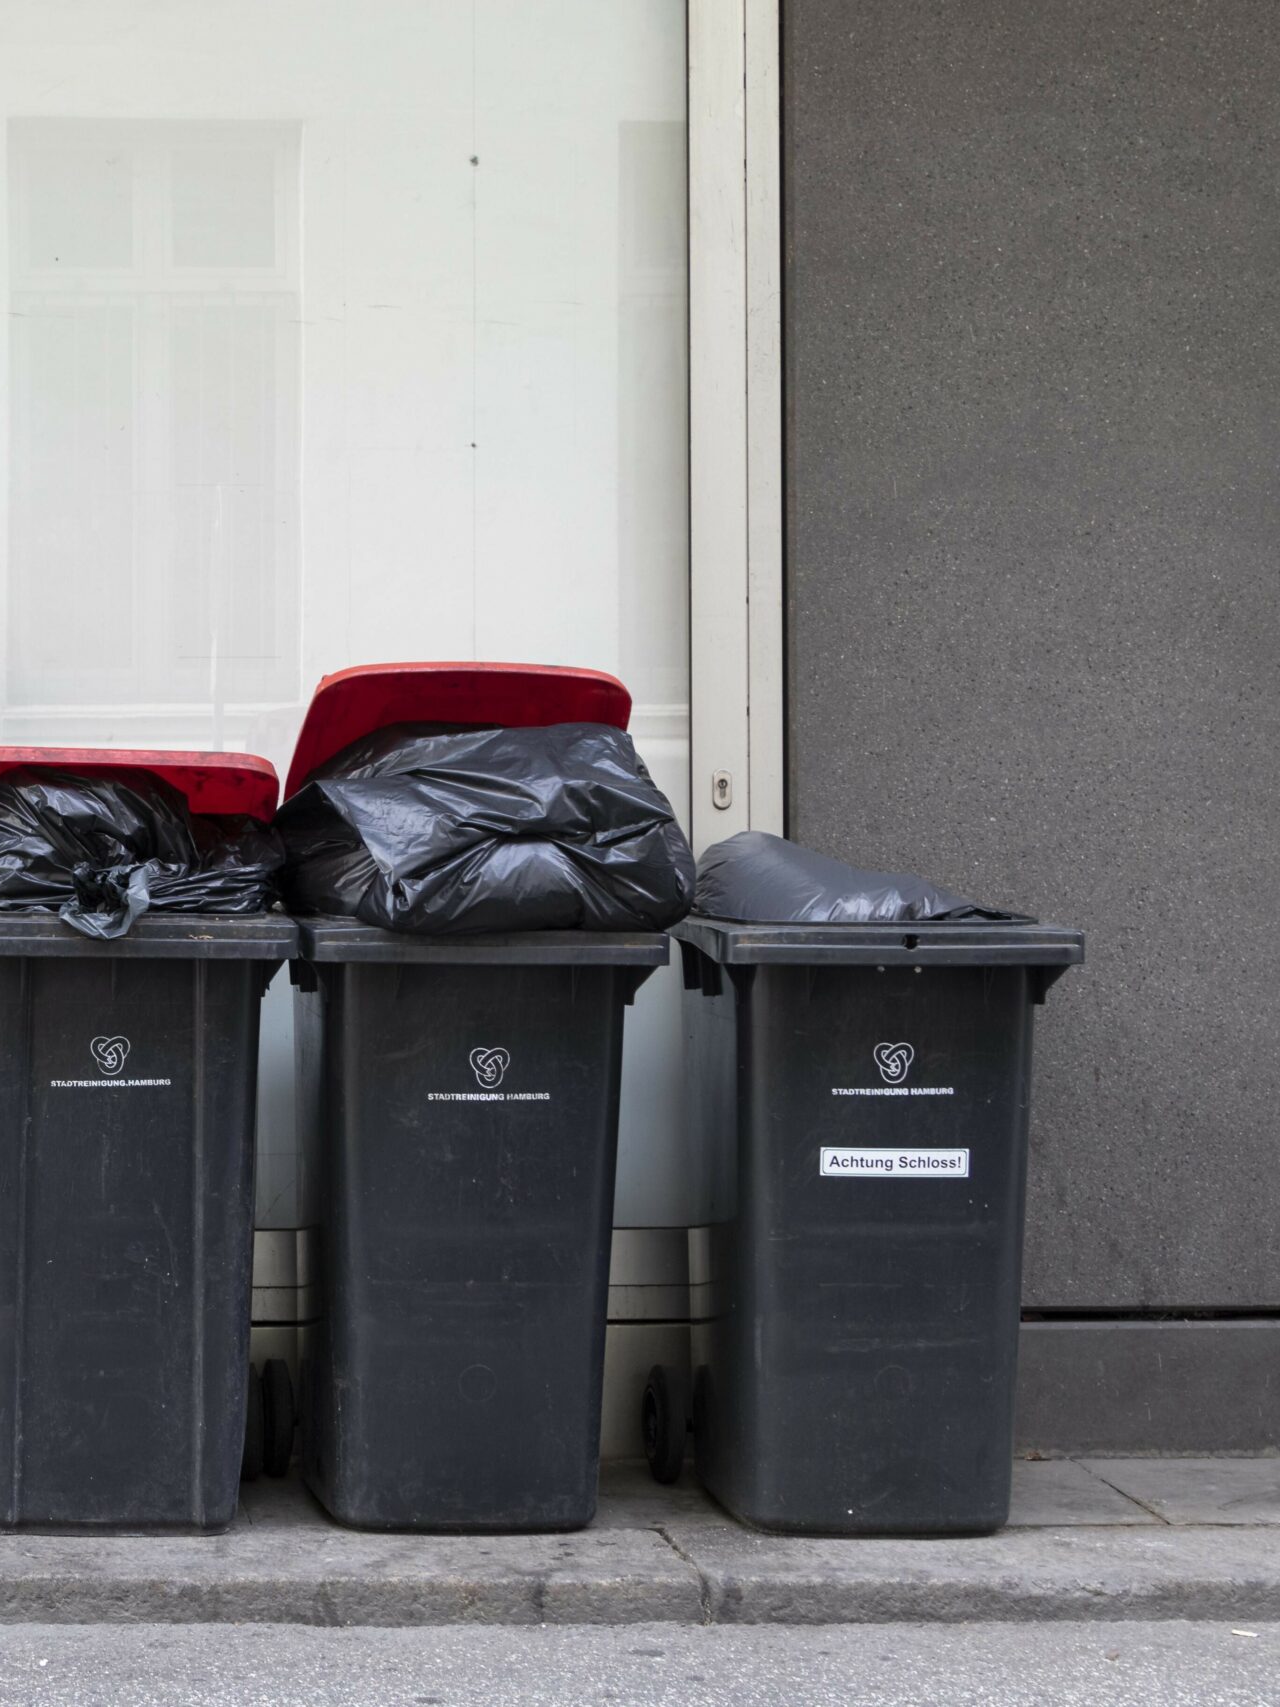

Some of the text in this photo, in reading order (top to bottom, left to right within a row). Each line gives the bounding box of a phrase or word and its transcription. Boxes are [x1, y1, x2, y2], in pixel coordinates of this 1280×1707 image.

[50, 1078, 171, 1087] STADTREINIGUNG.HAMBURG
[831, 1087, 954, 1096] STADTREINIGUNG HAMBURG
[427, 1092, 550, 1101] STADTREINIGUNG HAMBURG
[829, 1155, 961, 1171] Achtung Schloss!
